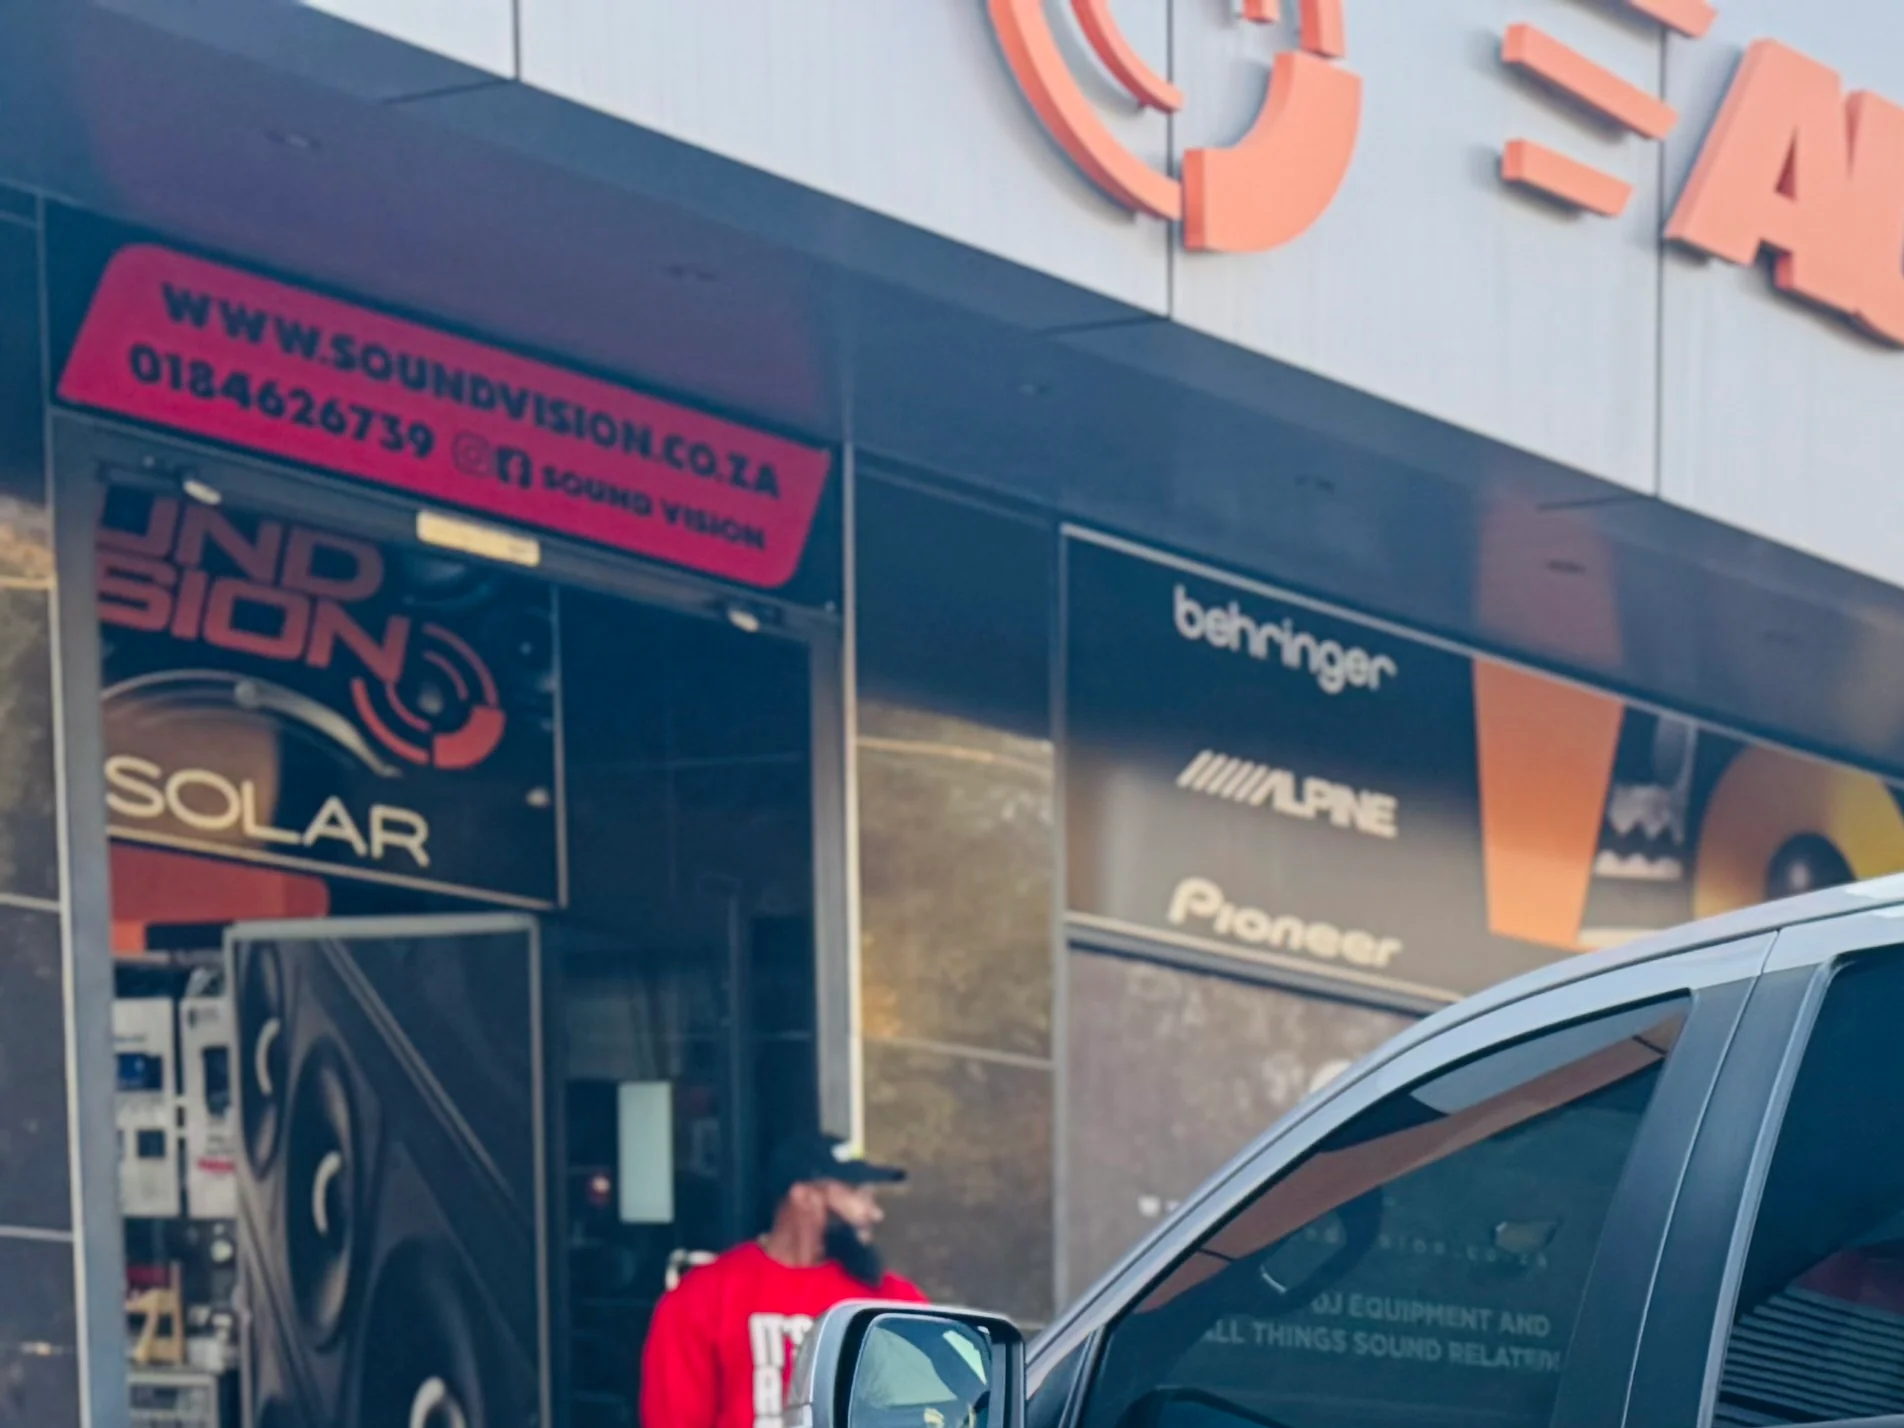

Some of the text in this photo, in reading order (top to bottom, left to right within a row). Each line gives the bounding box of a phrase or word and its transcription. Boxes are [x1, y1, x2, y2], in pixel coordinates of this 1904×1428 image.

[128, 344, 435, 458] 0184626739
[161, 282, 781, 499] WWW.SOUNDVISION.CO.ZA
[541, 463, 767, 551] SOUND VISION
[1173, 584, 1397, 694] behringer
[104, 755, 430, 867] SOLAR
[1246, 763, 1397, 839] ALPINE
[1168, 876, 1402, 968] Pioneer
[1252, 1320, 1348, 1355] THINGS
[1353, 1329, 1443, 1363] SOUND
[1348, 1292, 1493, 1332] EQUIPMENT
[1498, 1310, 1552, 1339] AND
